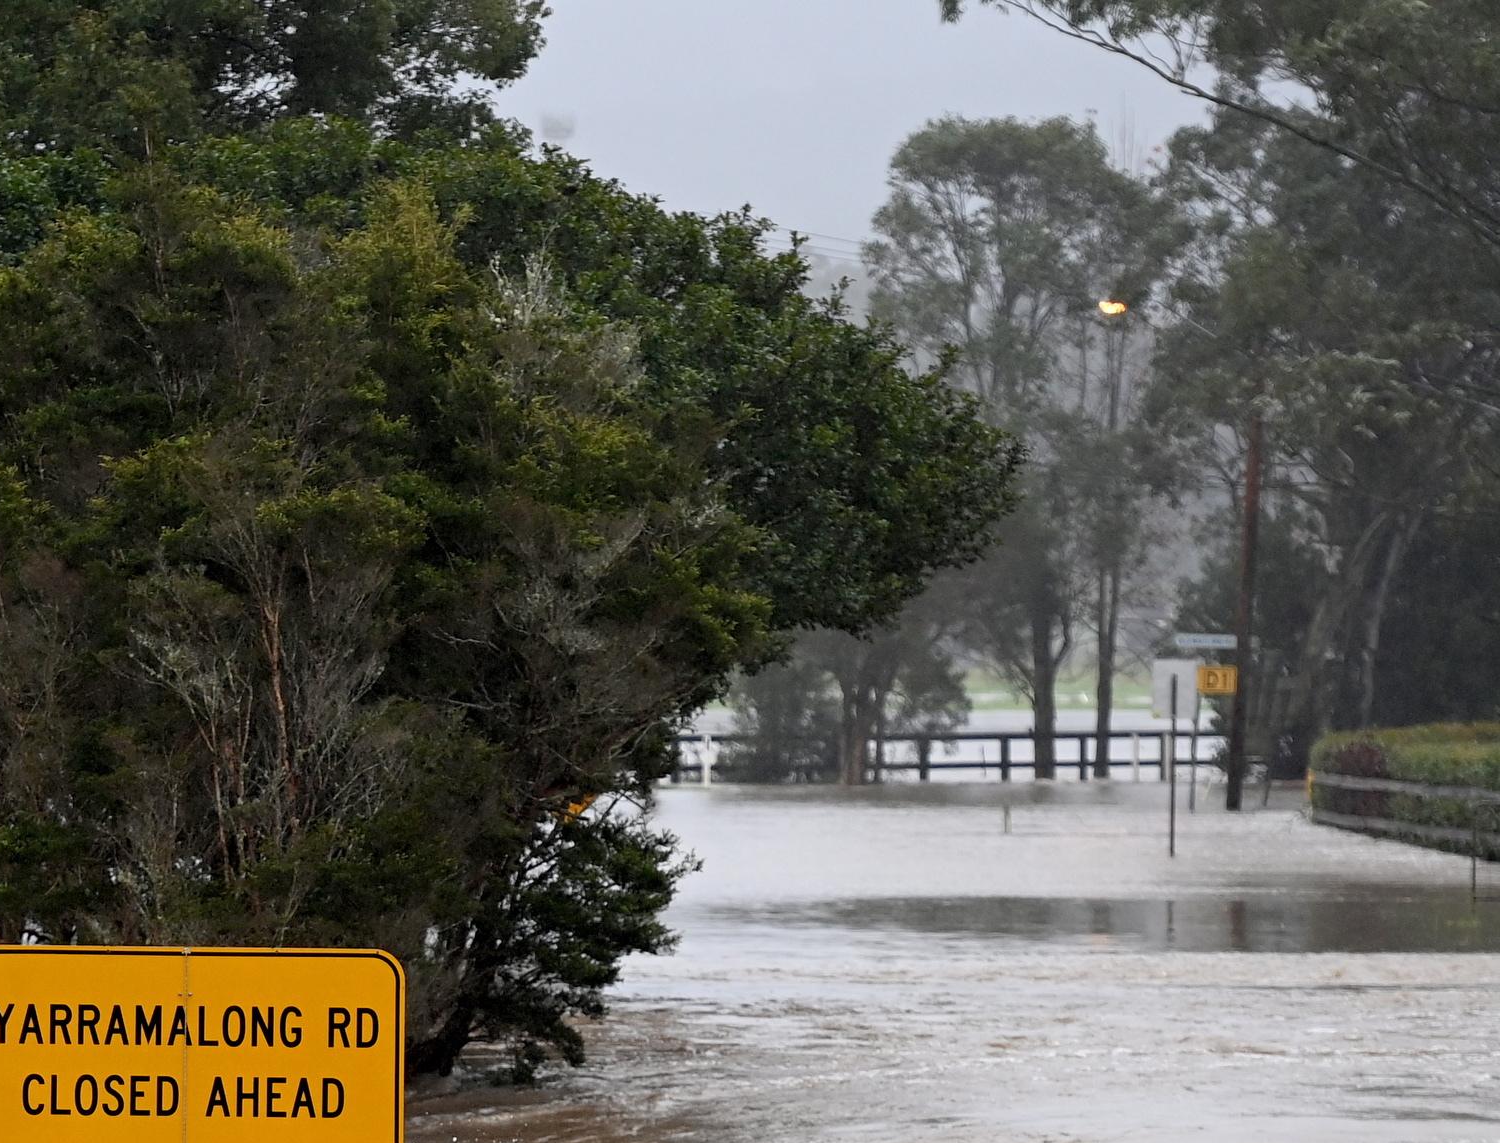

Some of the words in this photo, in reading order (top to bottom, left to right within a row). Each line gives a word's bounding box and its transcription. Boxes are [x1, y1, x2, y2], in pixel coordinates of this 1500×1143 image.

[327, 1007, 379, 1049] RD
[22, 1073, 180, 1117] CLOSED
[205, 1076, 345, 1119] AHEAD
